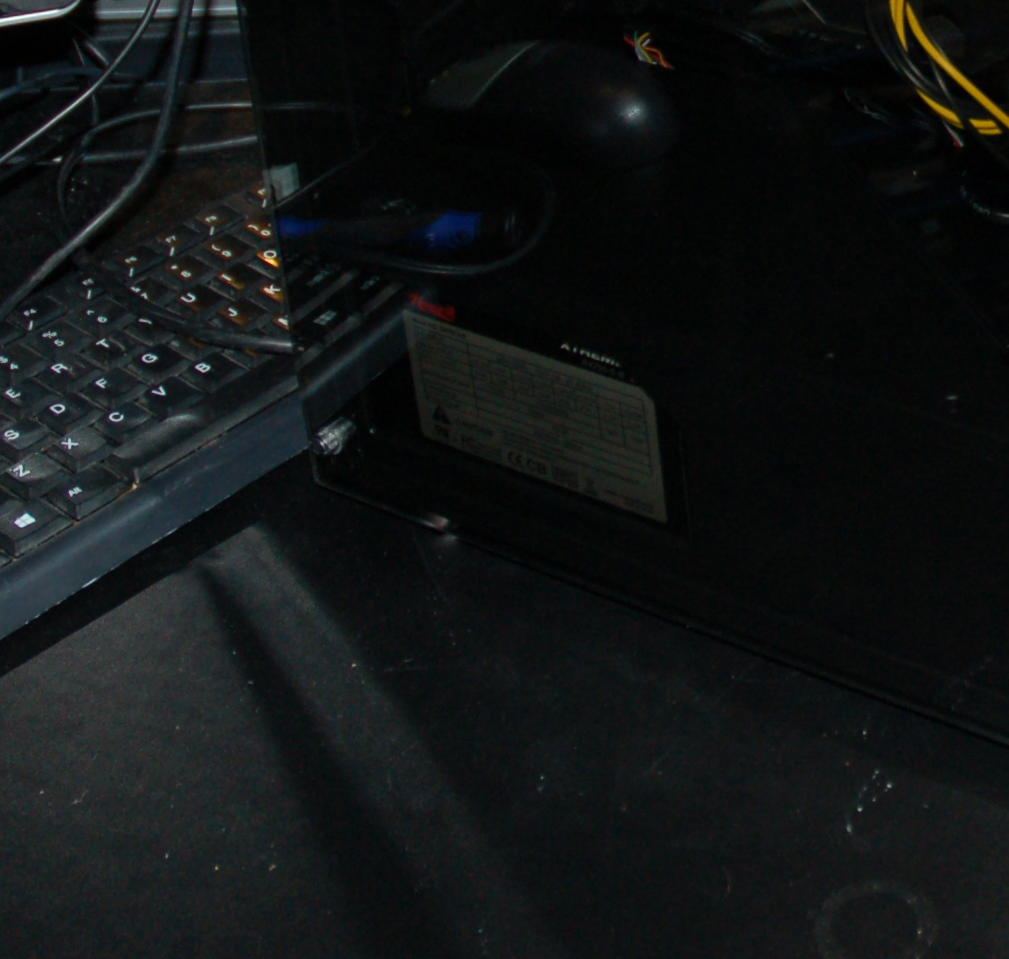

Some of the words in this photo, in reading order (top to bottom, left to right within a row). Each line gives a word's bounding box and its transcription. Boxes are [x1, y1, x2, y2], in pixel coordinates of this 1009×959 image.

[263, 284, 281, 294] K
[180, 292, 197, 303] U
[96, 338, 110, 348] T
[141, 353, 159, 363] G
[51, 363, 69, 373] R
[194, 362, 211, 373] B
[95, 378, 108, 389] F
[5, 387, 21, 399] E
[151, 385, 166, 396] V
[50, 403, 66, 415] D
[109, 412, 124, 422] C
[4, 429, 20, 440] S
[61, 438, 79, 450] X
[13, 464, 30, 477] Z
